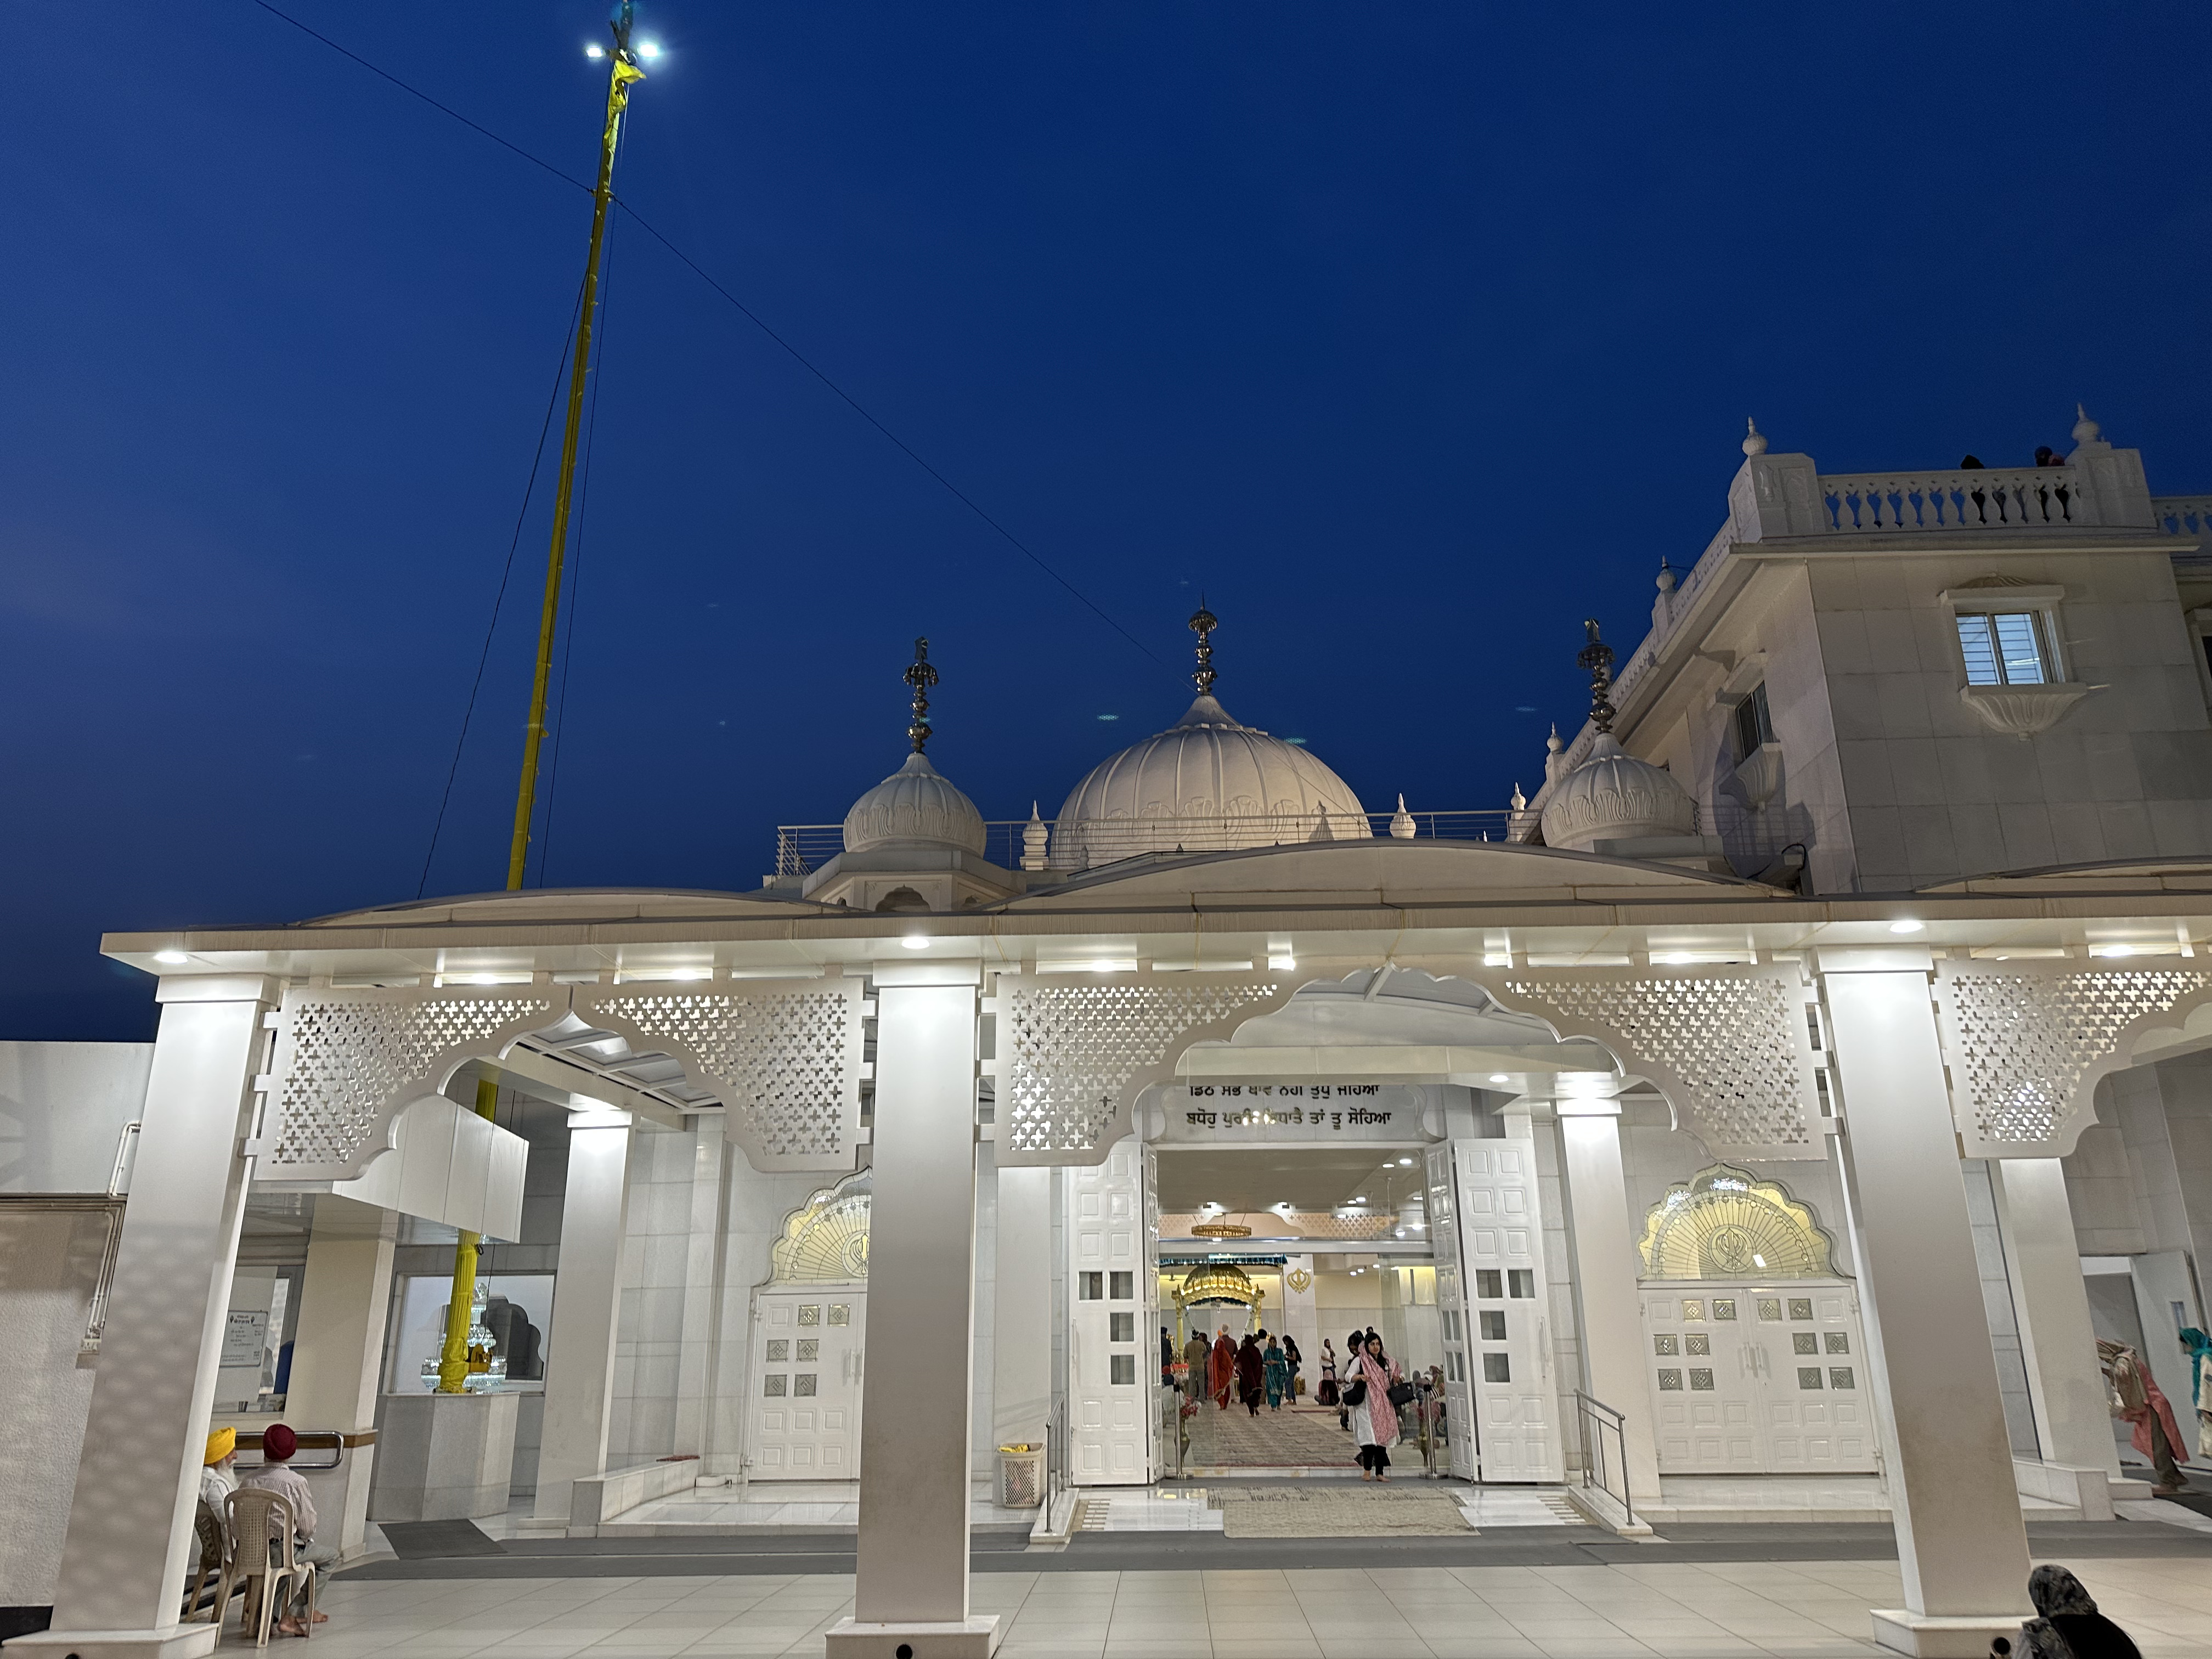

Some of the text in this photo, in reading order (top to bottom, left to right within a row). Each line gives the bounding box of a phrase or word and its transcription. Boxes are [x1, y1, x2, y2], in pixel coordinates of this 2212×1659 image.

[1309, 1108, 1325, 1125] ਤਾਂ
[1330, 1113, 1342, 1130] ਤੂ
[1347, 1106, 1392, 1125] ਸੋਹਿਆ
